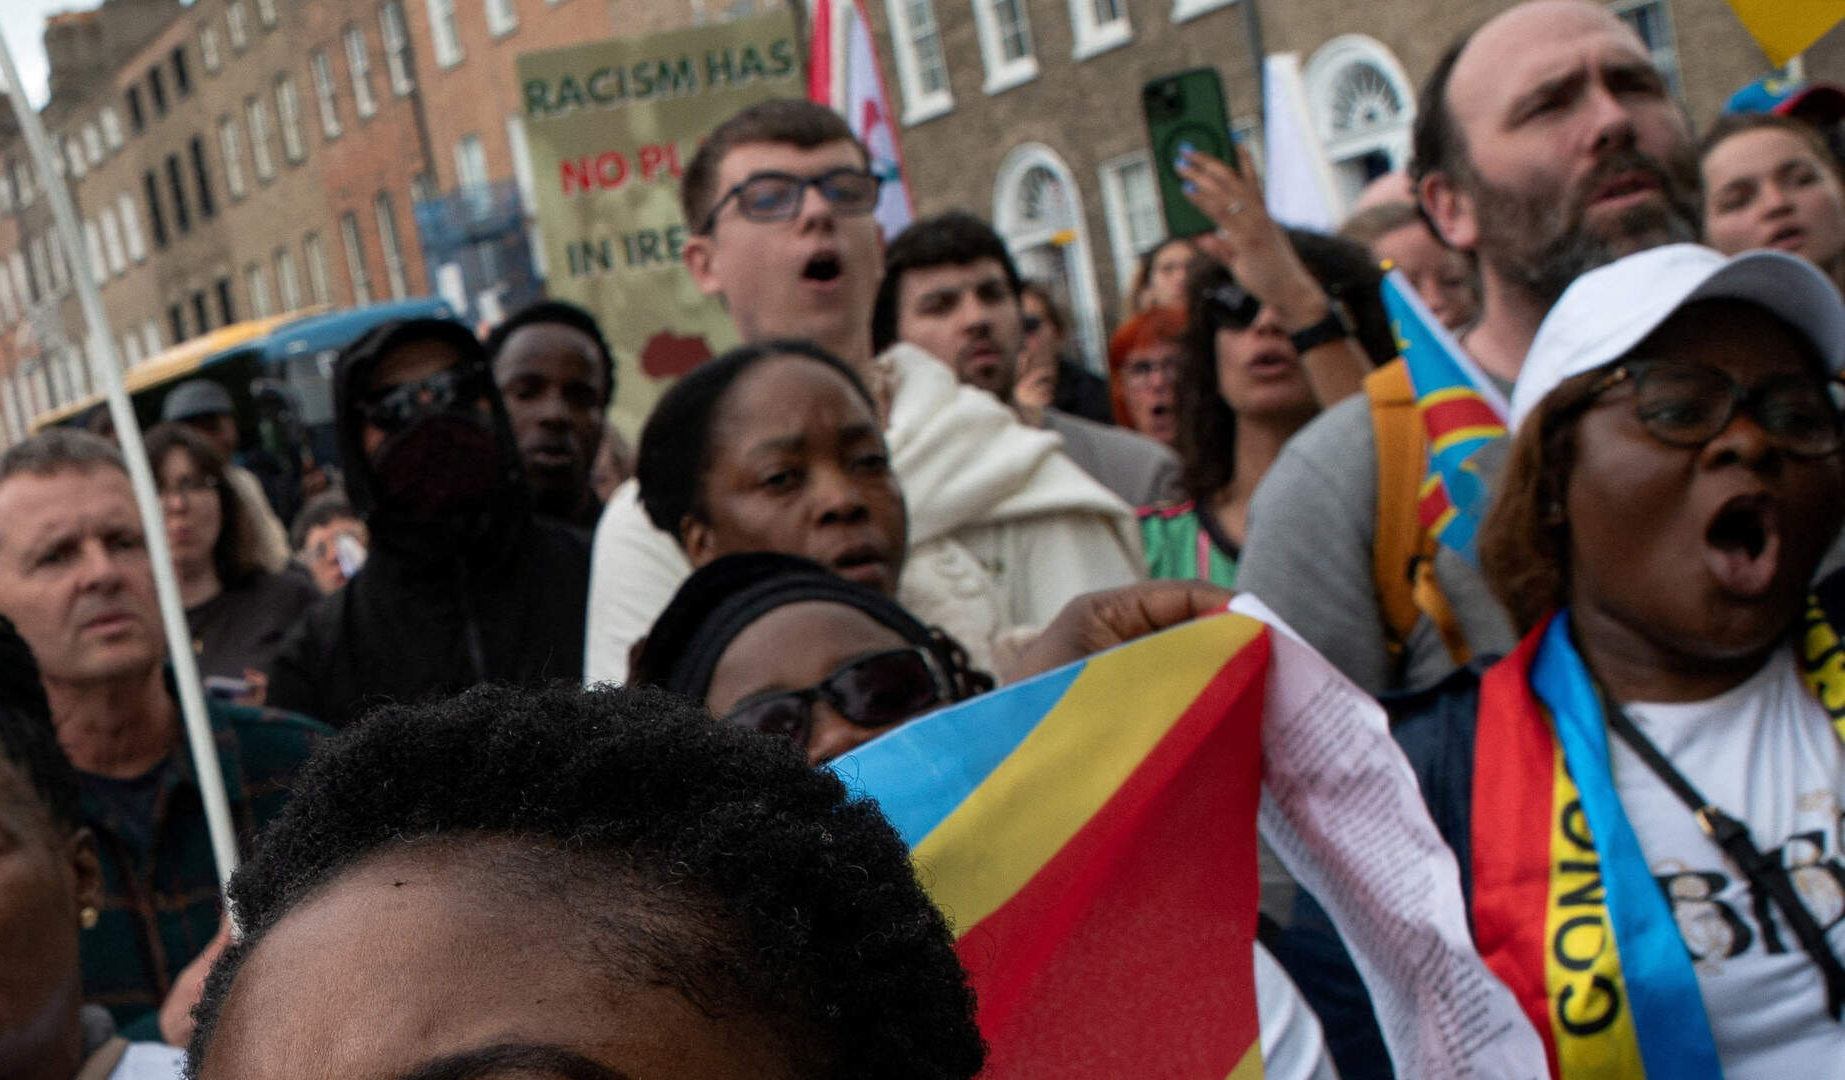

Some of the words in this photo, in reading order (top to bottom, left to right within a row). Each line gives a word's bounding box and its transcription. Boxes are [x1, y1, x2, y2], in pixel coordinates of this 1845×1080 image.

[525, 55, 697, 114] RACISM
[706, 38, 794, 87] HAS
[560, 151, 629, 196] NO
[566, 238, 612, 278] IN
